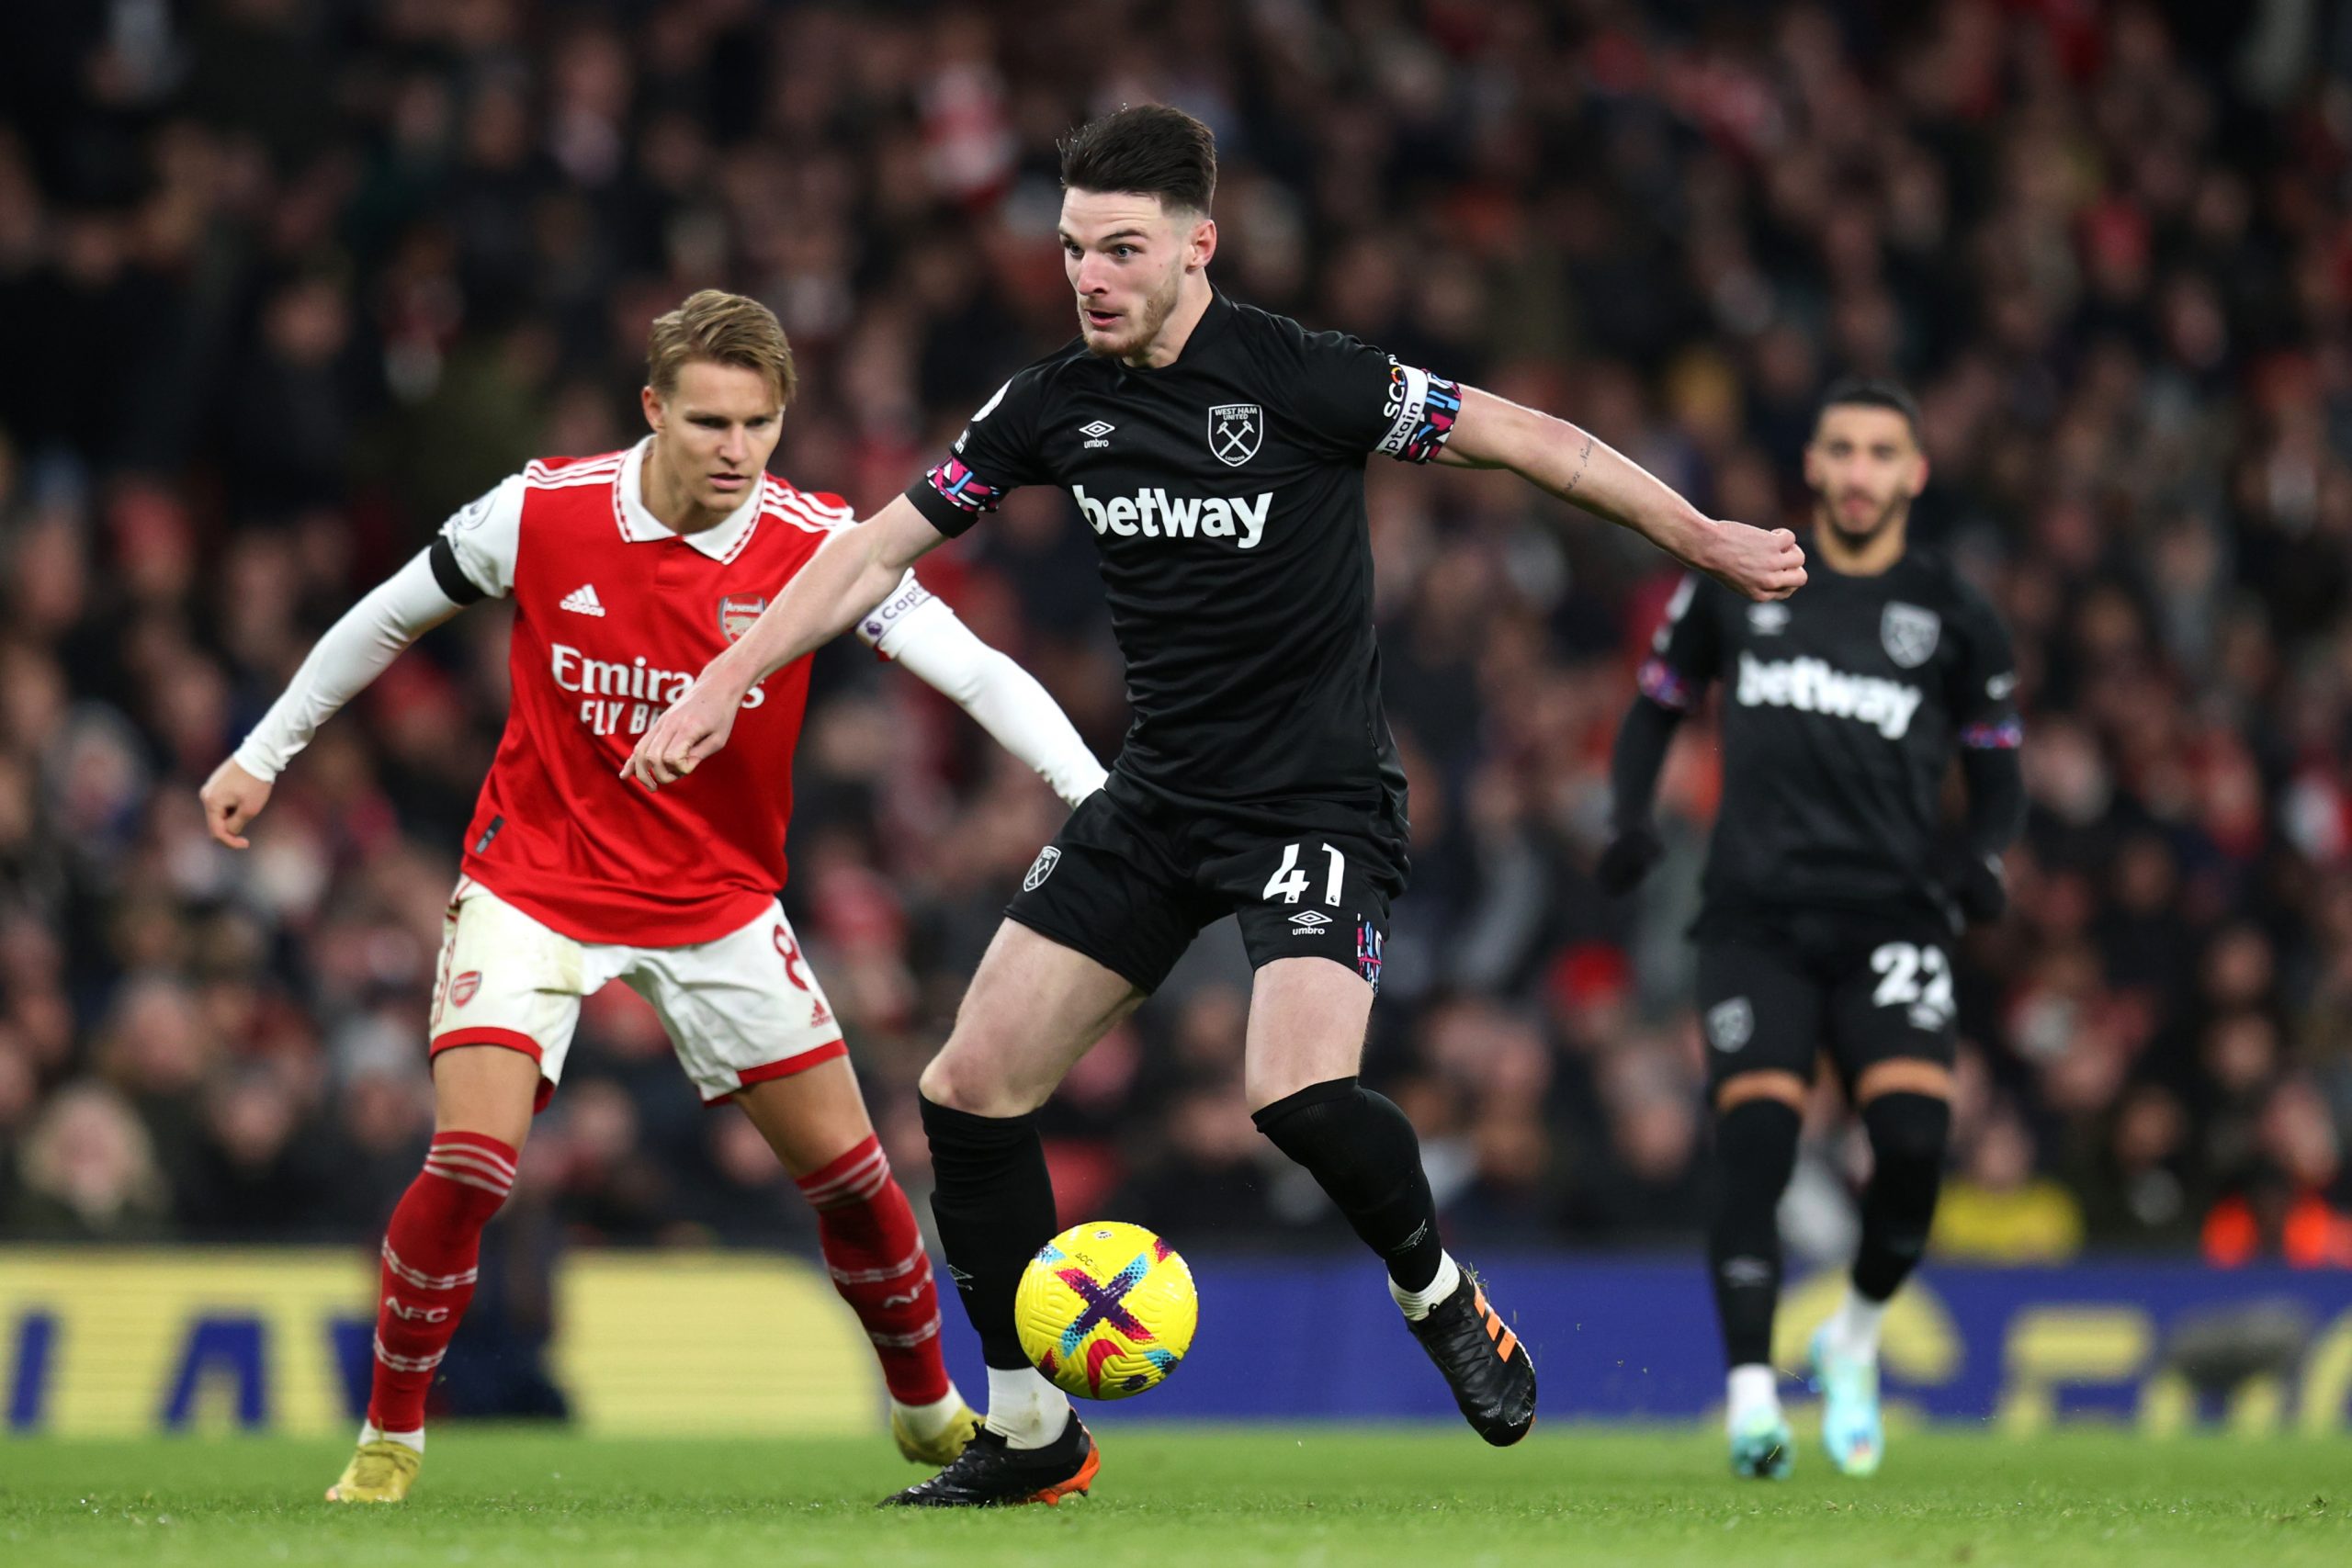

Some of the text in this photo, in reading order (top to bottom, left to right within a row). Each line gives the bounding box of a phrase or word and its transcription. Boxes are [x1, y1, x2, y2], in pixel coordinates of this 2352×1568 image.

[1215, 408, 1237, 416] WEST
[1084, 438, 1109, 448] umbro
[1072, 485, 1273, 549] betway
[559, 598, 606, 618] adidas
[551, 642, 765, 709] Emiras
[1736, 651, 1923, 740] betway
[579, 698, 626, 736] FLY
[1262, 842, 1345, 908] 41
[1292, 926, 1326, 936] umbro
[774, 924, 809, 992] 8
[386, 1296, 449, 1323] AFC
